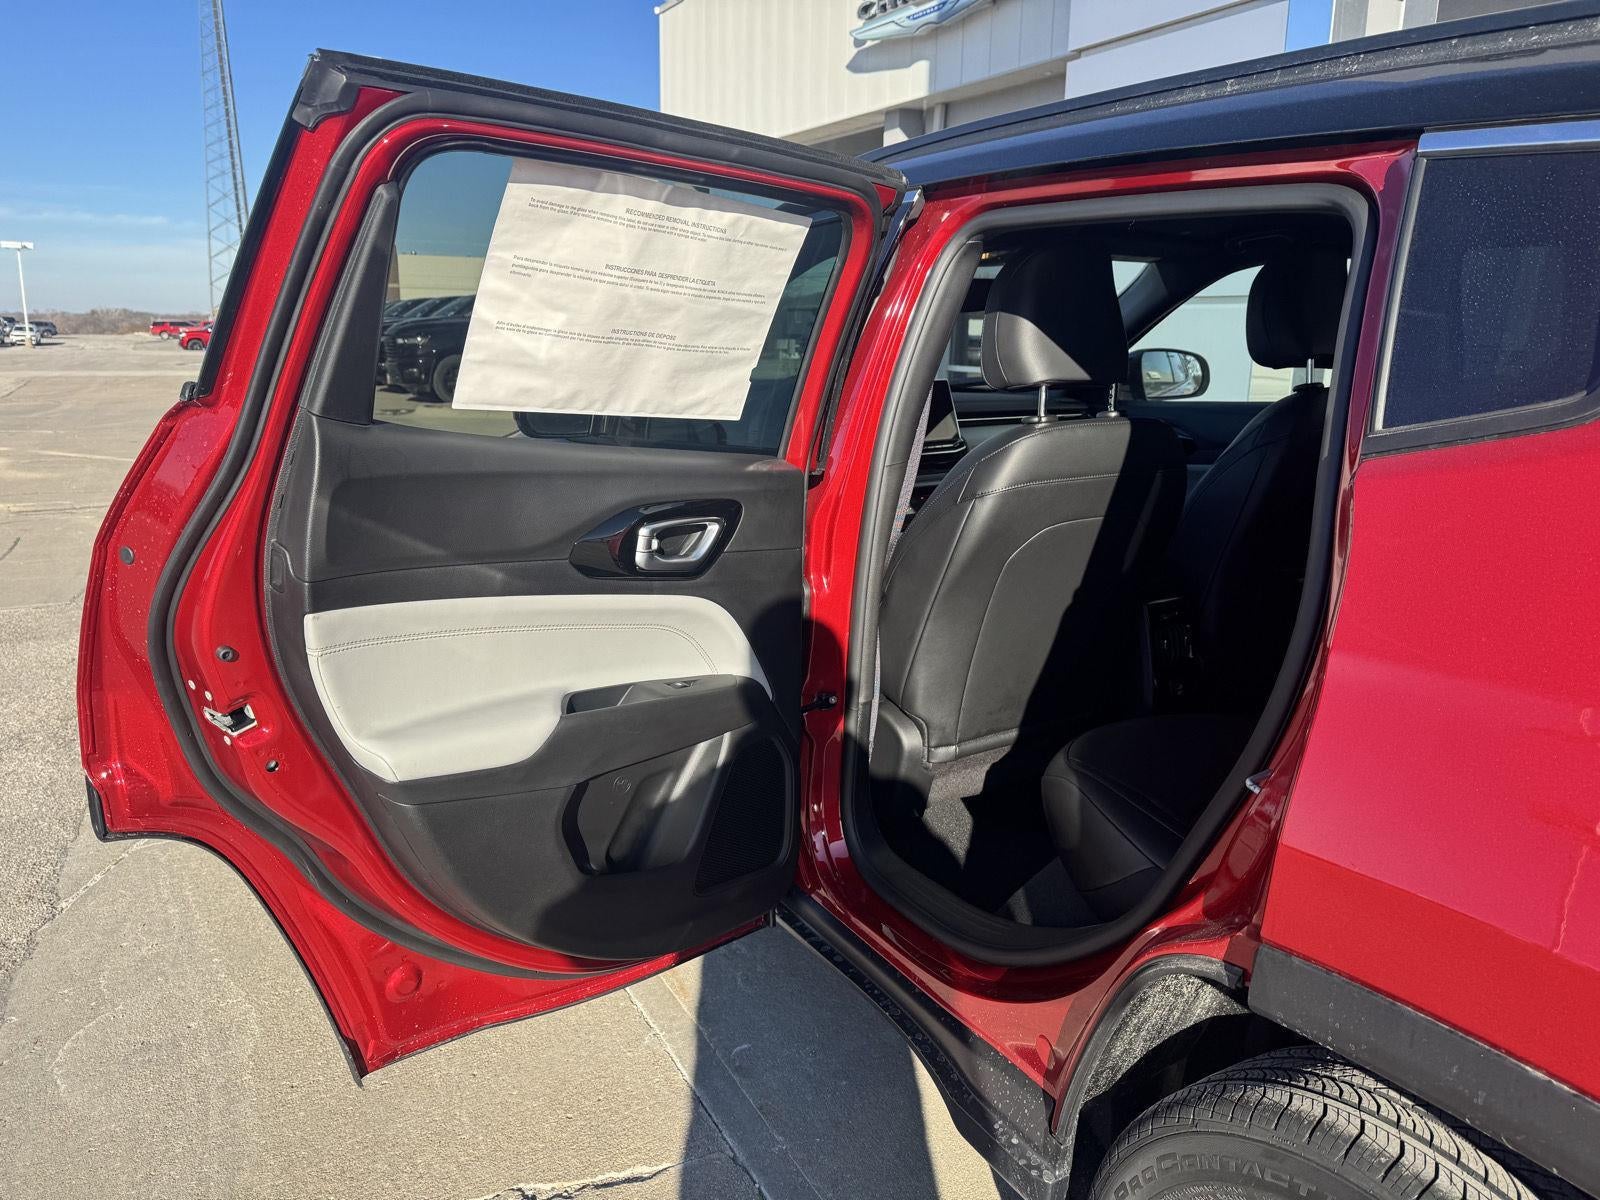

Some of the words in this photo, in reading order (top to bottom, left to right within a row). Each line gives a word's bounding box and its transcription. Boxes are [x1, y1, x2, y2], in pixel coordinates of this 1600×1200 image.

[599, 211, 618, 220] removing
[625, 208, 666, 222] RECOMMENDED
[666, 215, 690, 226] REMOVAL
[690, 220, 728, 234] INSTRUCTIONS
[604, 264, 644, 276] INSTRUCCIONES
[658, 272, 689, 283] DESPRENDER
[695, 278, 716, 286] ETIQUETA
[611, 328, 647, 337] INSTRUCTIONS
